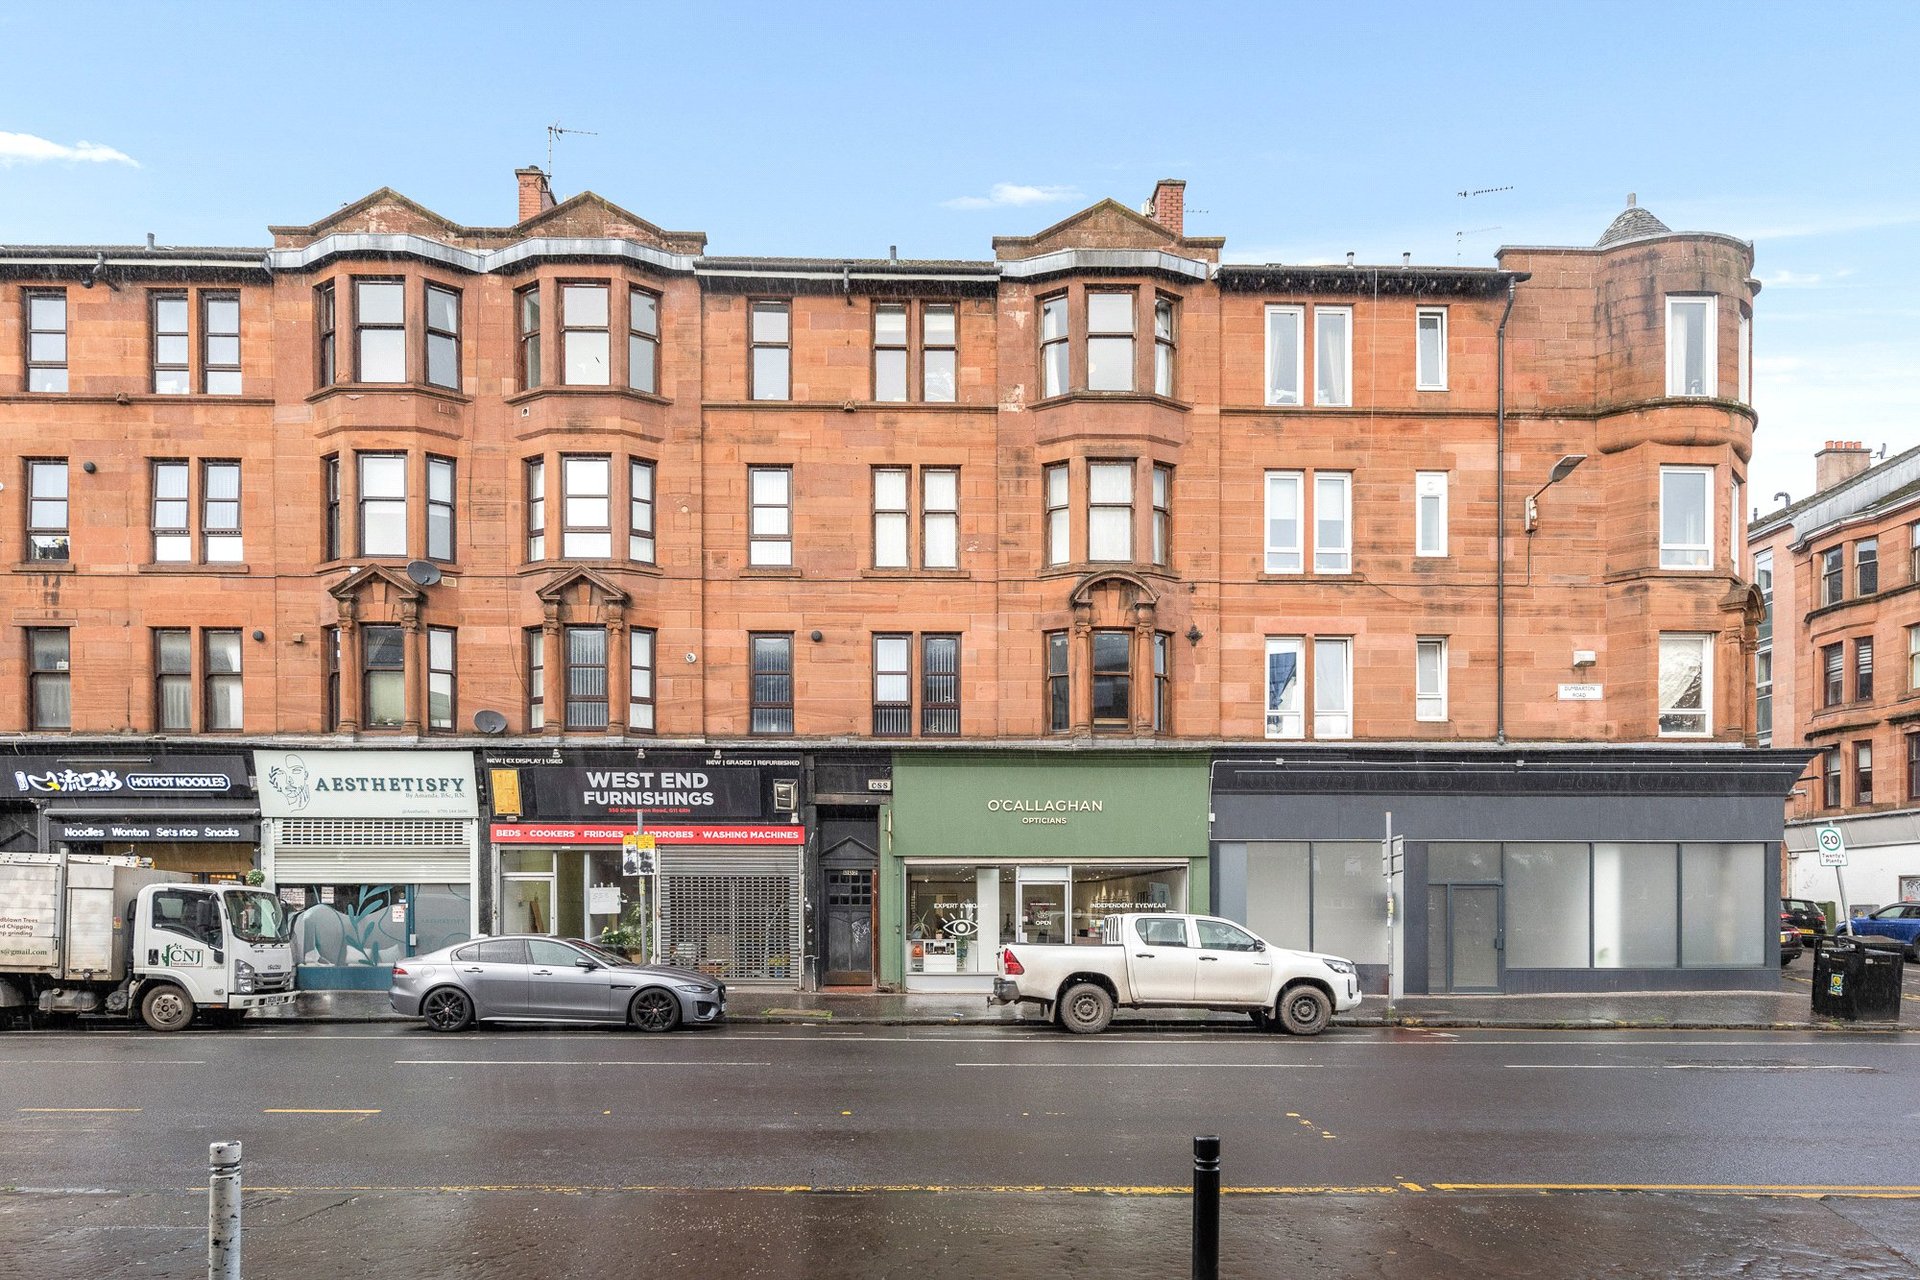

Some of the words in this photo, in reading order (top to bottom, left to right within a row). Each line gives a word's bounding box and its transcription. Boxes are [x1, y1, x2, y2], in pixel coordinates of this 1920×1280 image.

[130, 777, 175, 787] HOTPOT
[176, 777, 226, 787] NOODLES
[315, 778, 464, 791] AESTHETISFY
[586, 772, 654, 788] WEST
[661, 772, 709, 788] END
[583, 791, 715, 806] FURNISHINGS
[987, 799, 1103, 811] O'CALLAGHAN
[64, 827, 105, 837] Noodles
[112, 827, 150, 837] Wonton
[156, 827, 178, 837] Sets
[179, 828, 198, 837] rice
[204, 827, 240, 837] Snacks
[496, 829, 521, 838] BEDS
[530, 829, 575, 838] COOKERS
[584, 830, 624, 838] FRIDGES
[702, 831, 748, 839] WASHING
[750, 831, 798, 839] MACHINES
[1823, 835, 1838, 845] 20
[171, 950, 200, 964] CNJ
